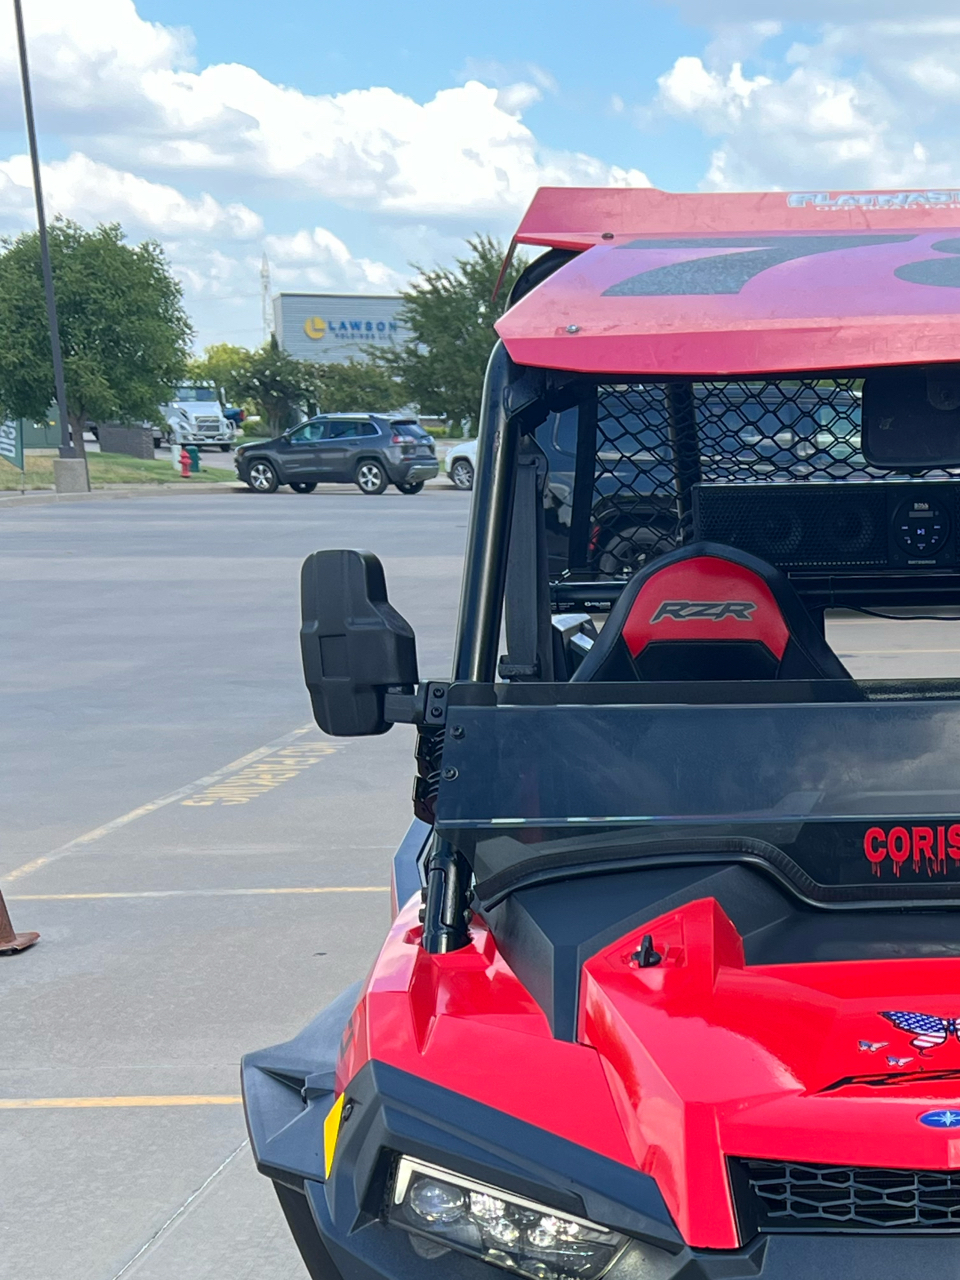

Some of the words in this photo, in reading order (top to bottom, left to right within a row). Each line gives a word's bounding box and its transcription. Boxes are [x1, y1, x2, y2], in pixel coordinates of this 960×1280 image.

[862, 203, 918, 211] ROAD
[328, 321, 397, 332] LAWSON
[650, 600, 757, 624] RZR
